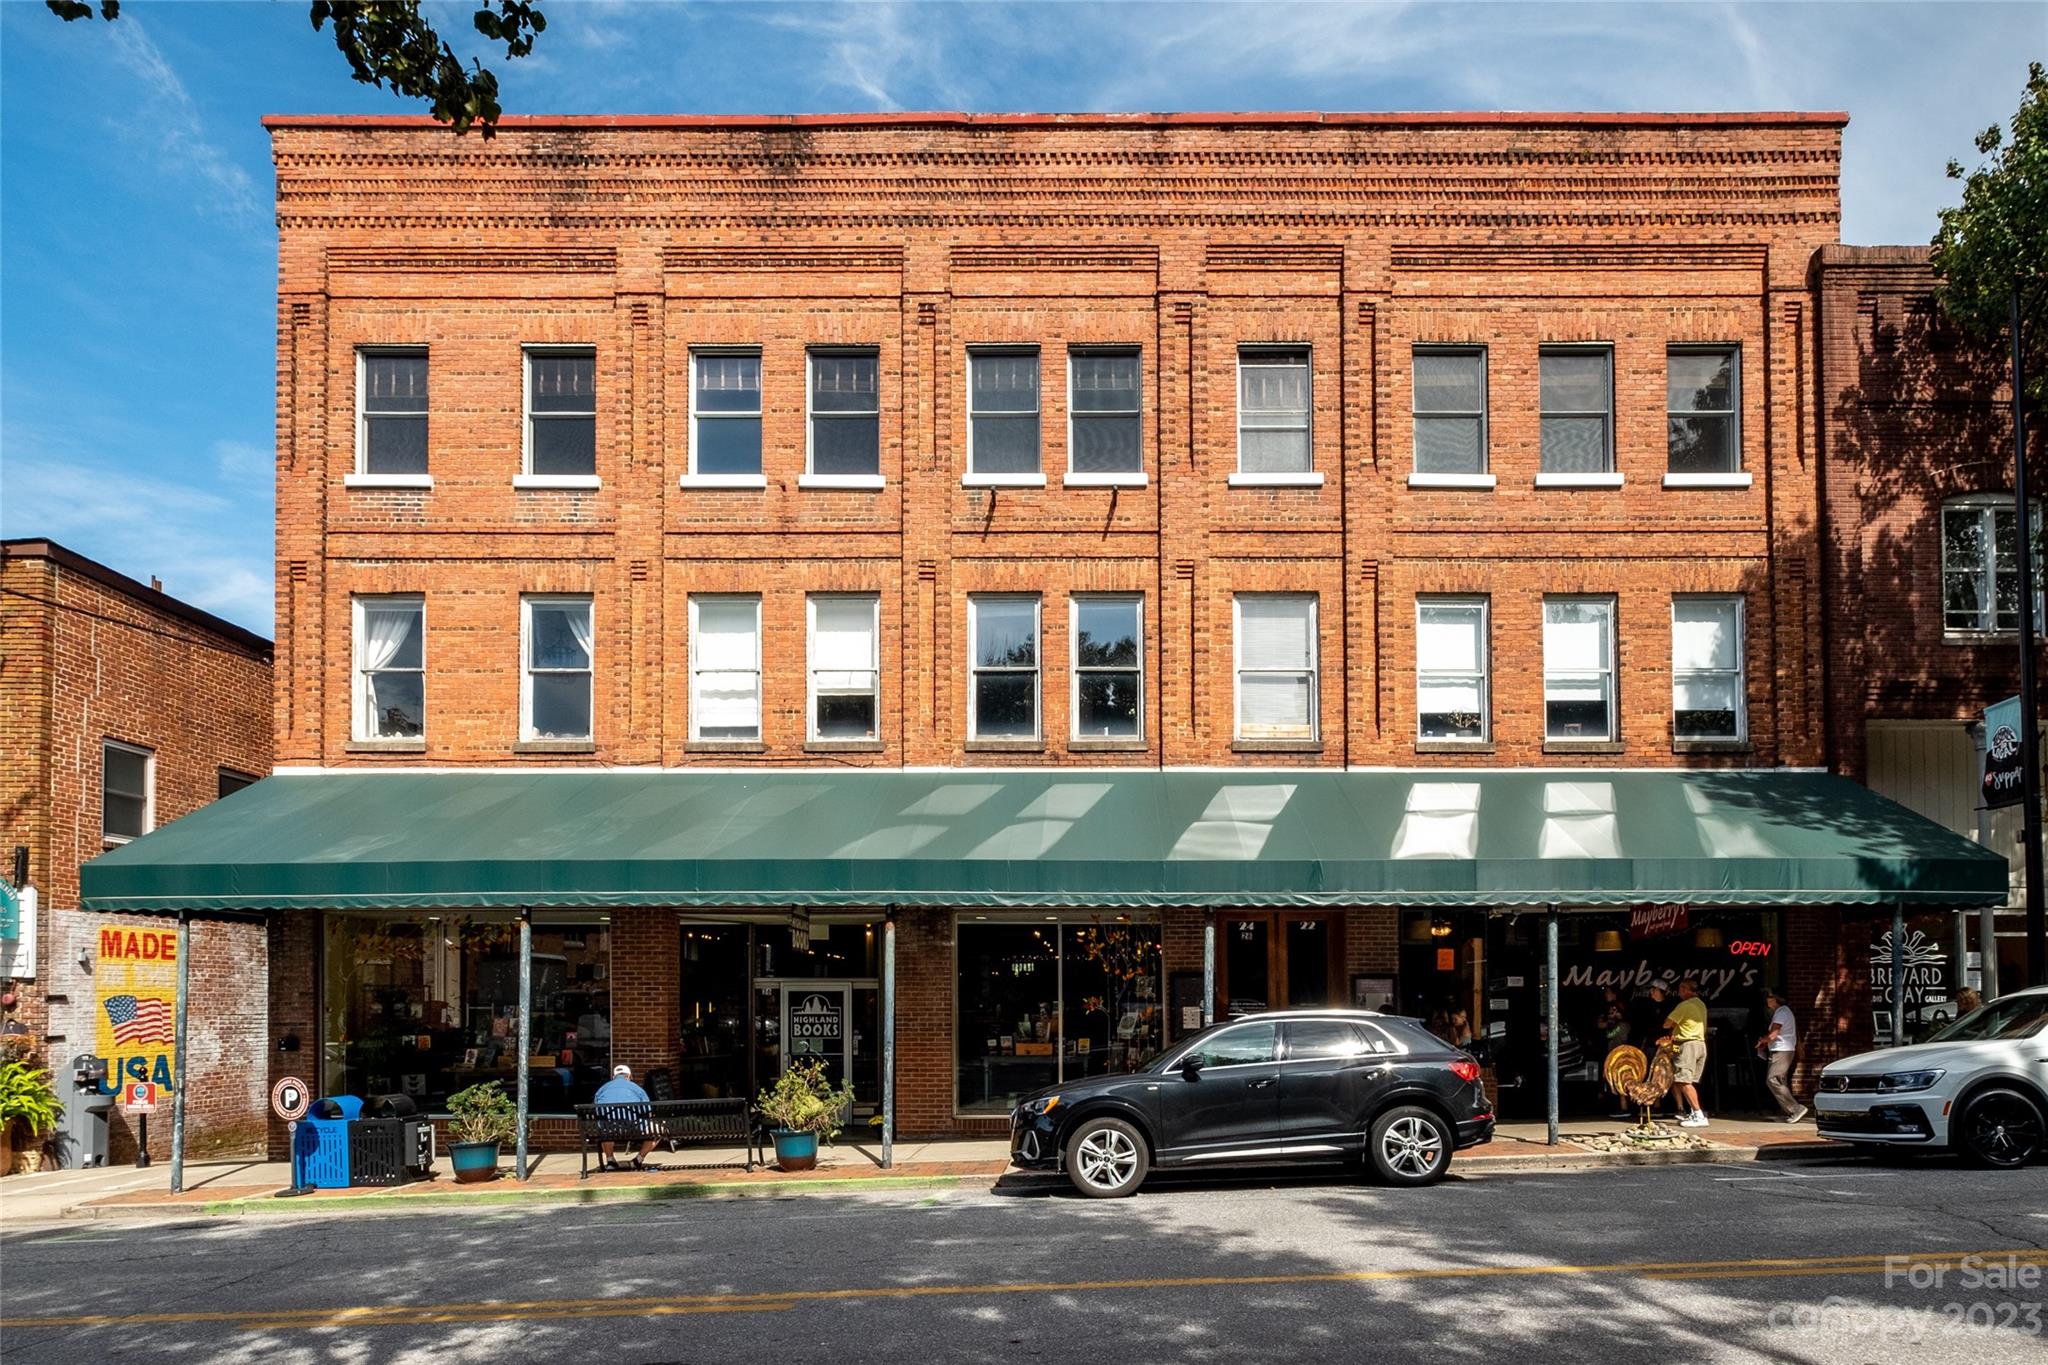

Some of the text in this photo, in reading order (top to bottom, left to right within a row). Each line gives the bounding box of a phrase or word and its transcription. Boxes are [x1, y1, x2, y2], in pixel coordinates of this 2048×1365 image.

[101, 929, 177, 960] MADE
[1729, 940, 1771, 956] OPEN
[1884, 986, 1925, 1003] CAY
[1924, 995, 1947, 1003] GALLERY
[793, 1016, 839, 1024] HIGHLAND
[793, 1024, 839, 1036] BOOKS
[285, 1089, 299, 1108] P
